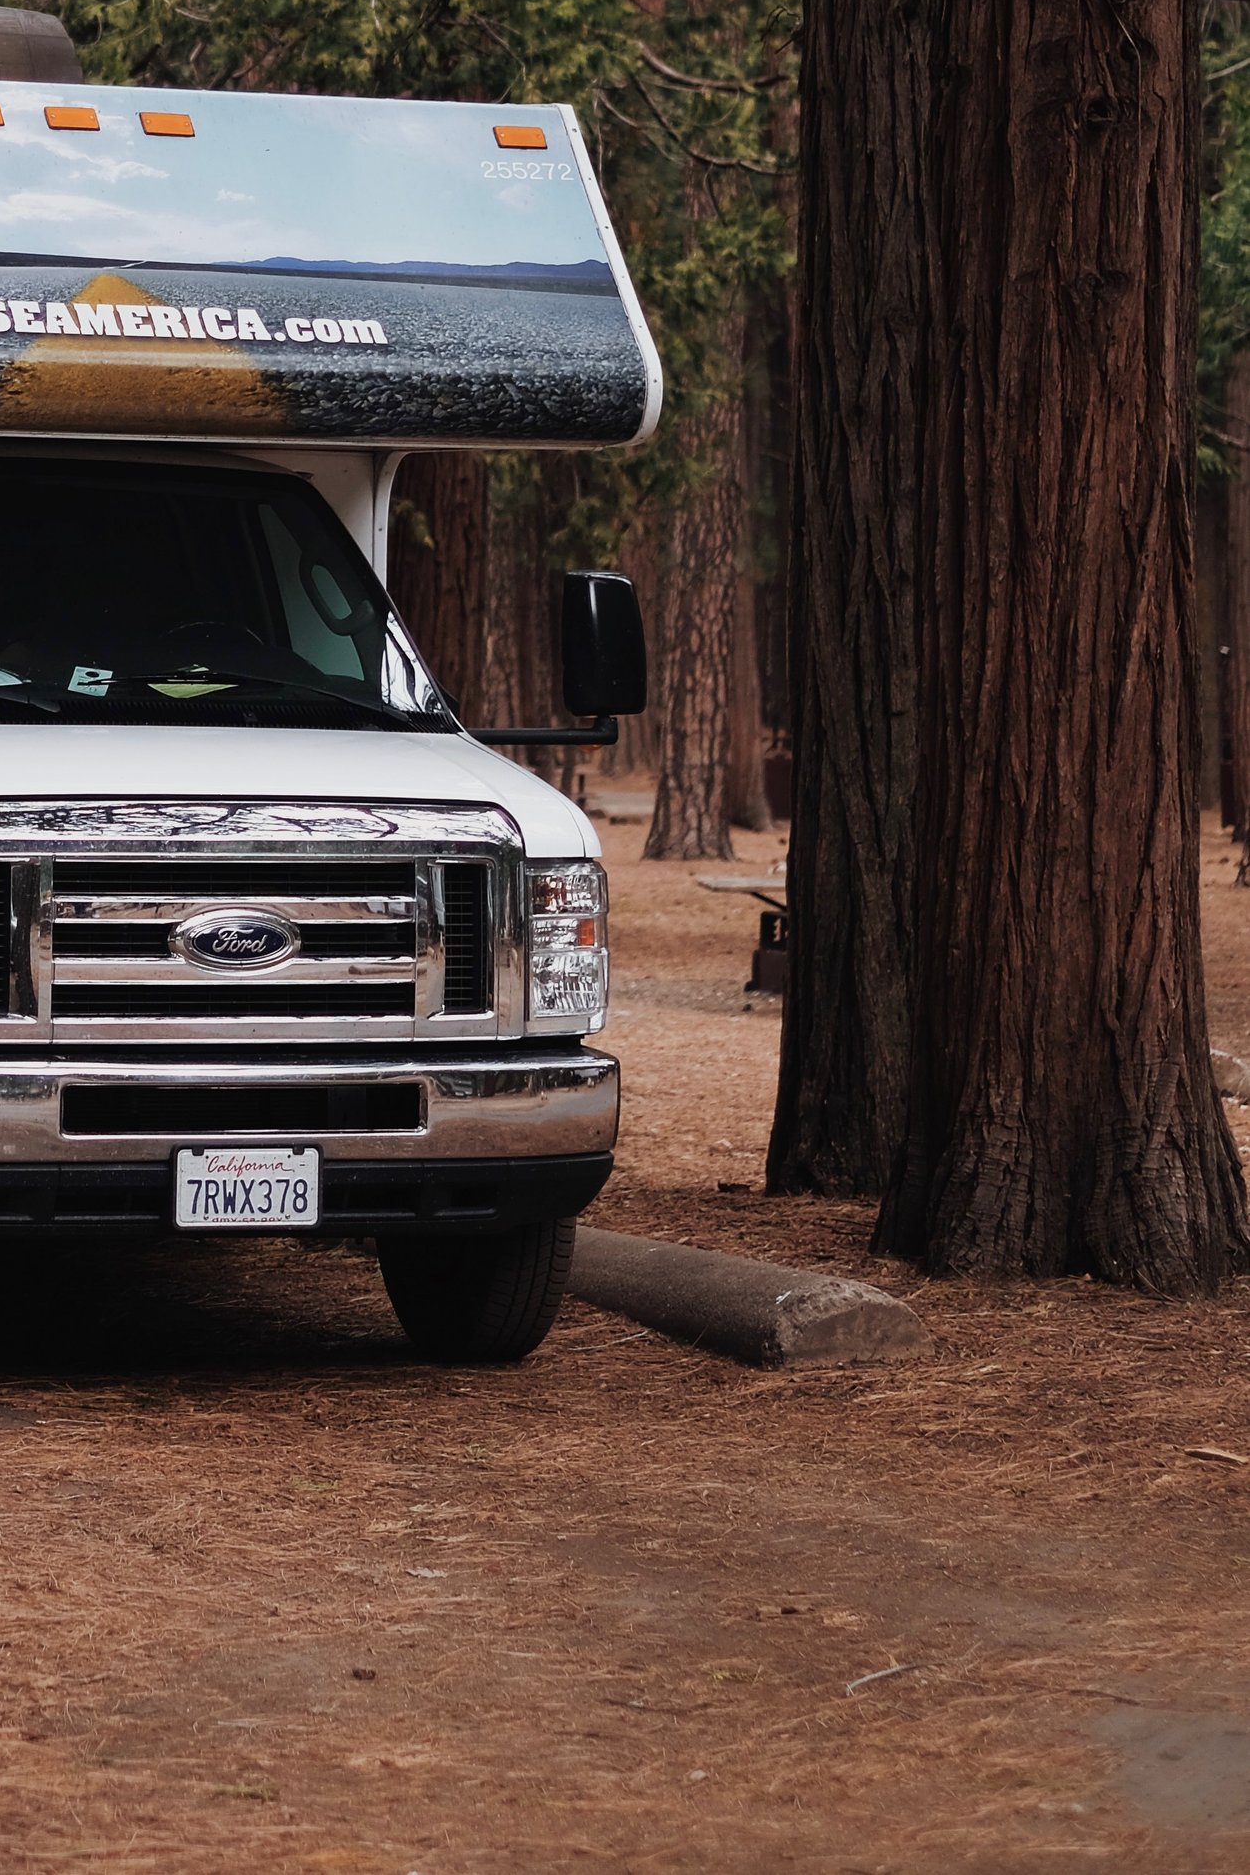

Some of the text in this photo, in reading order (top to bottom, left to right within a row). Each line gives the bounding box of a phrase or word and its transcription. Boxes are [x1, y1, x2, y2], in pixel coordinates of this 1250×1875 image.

[480, 160, 575, 181] 255272
[212, 927, 269, 954] Ford
[206, 1155, 295, 1178] California
[186, 1178, 309, 1215] 7RWX378
